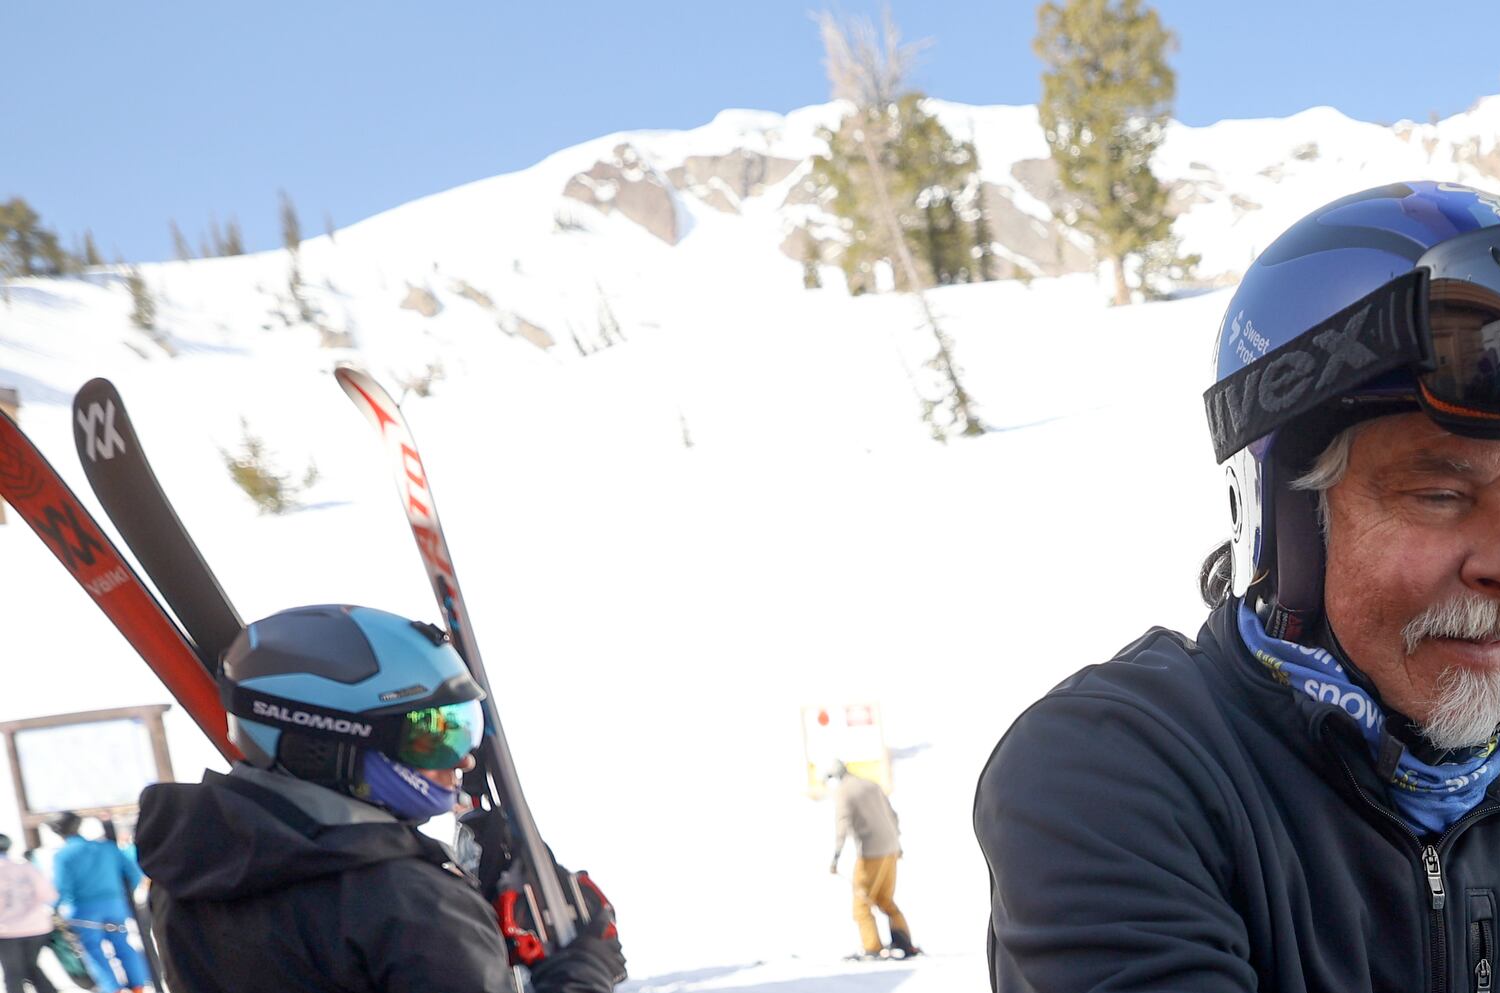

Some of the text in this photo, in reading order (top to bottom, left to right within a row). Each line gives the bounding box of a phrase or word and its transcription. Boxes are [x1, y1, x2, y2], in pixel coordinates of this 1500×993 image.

[1243, 319, 1270, 355] Sweet
[1206, 303, 1379, 448] uvex
[253, 700, 372, 738] SALOMON
